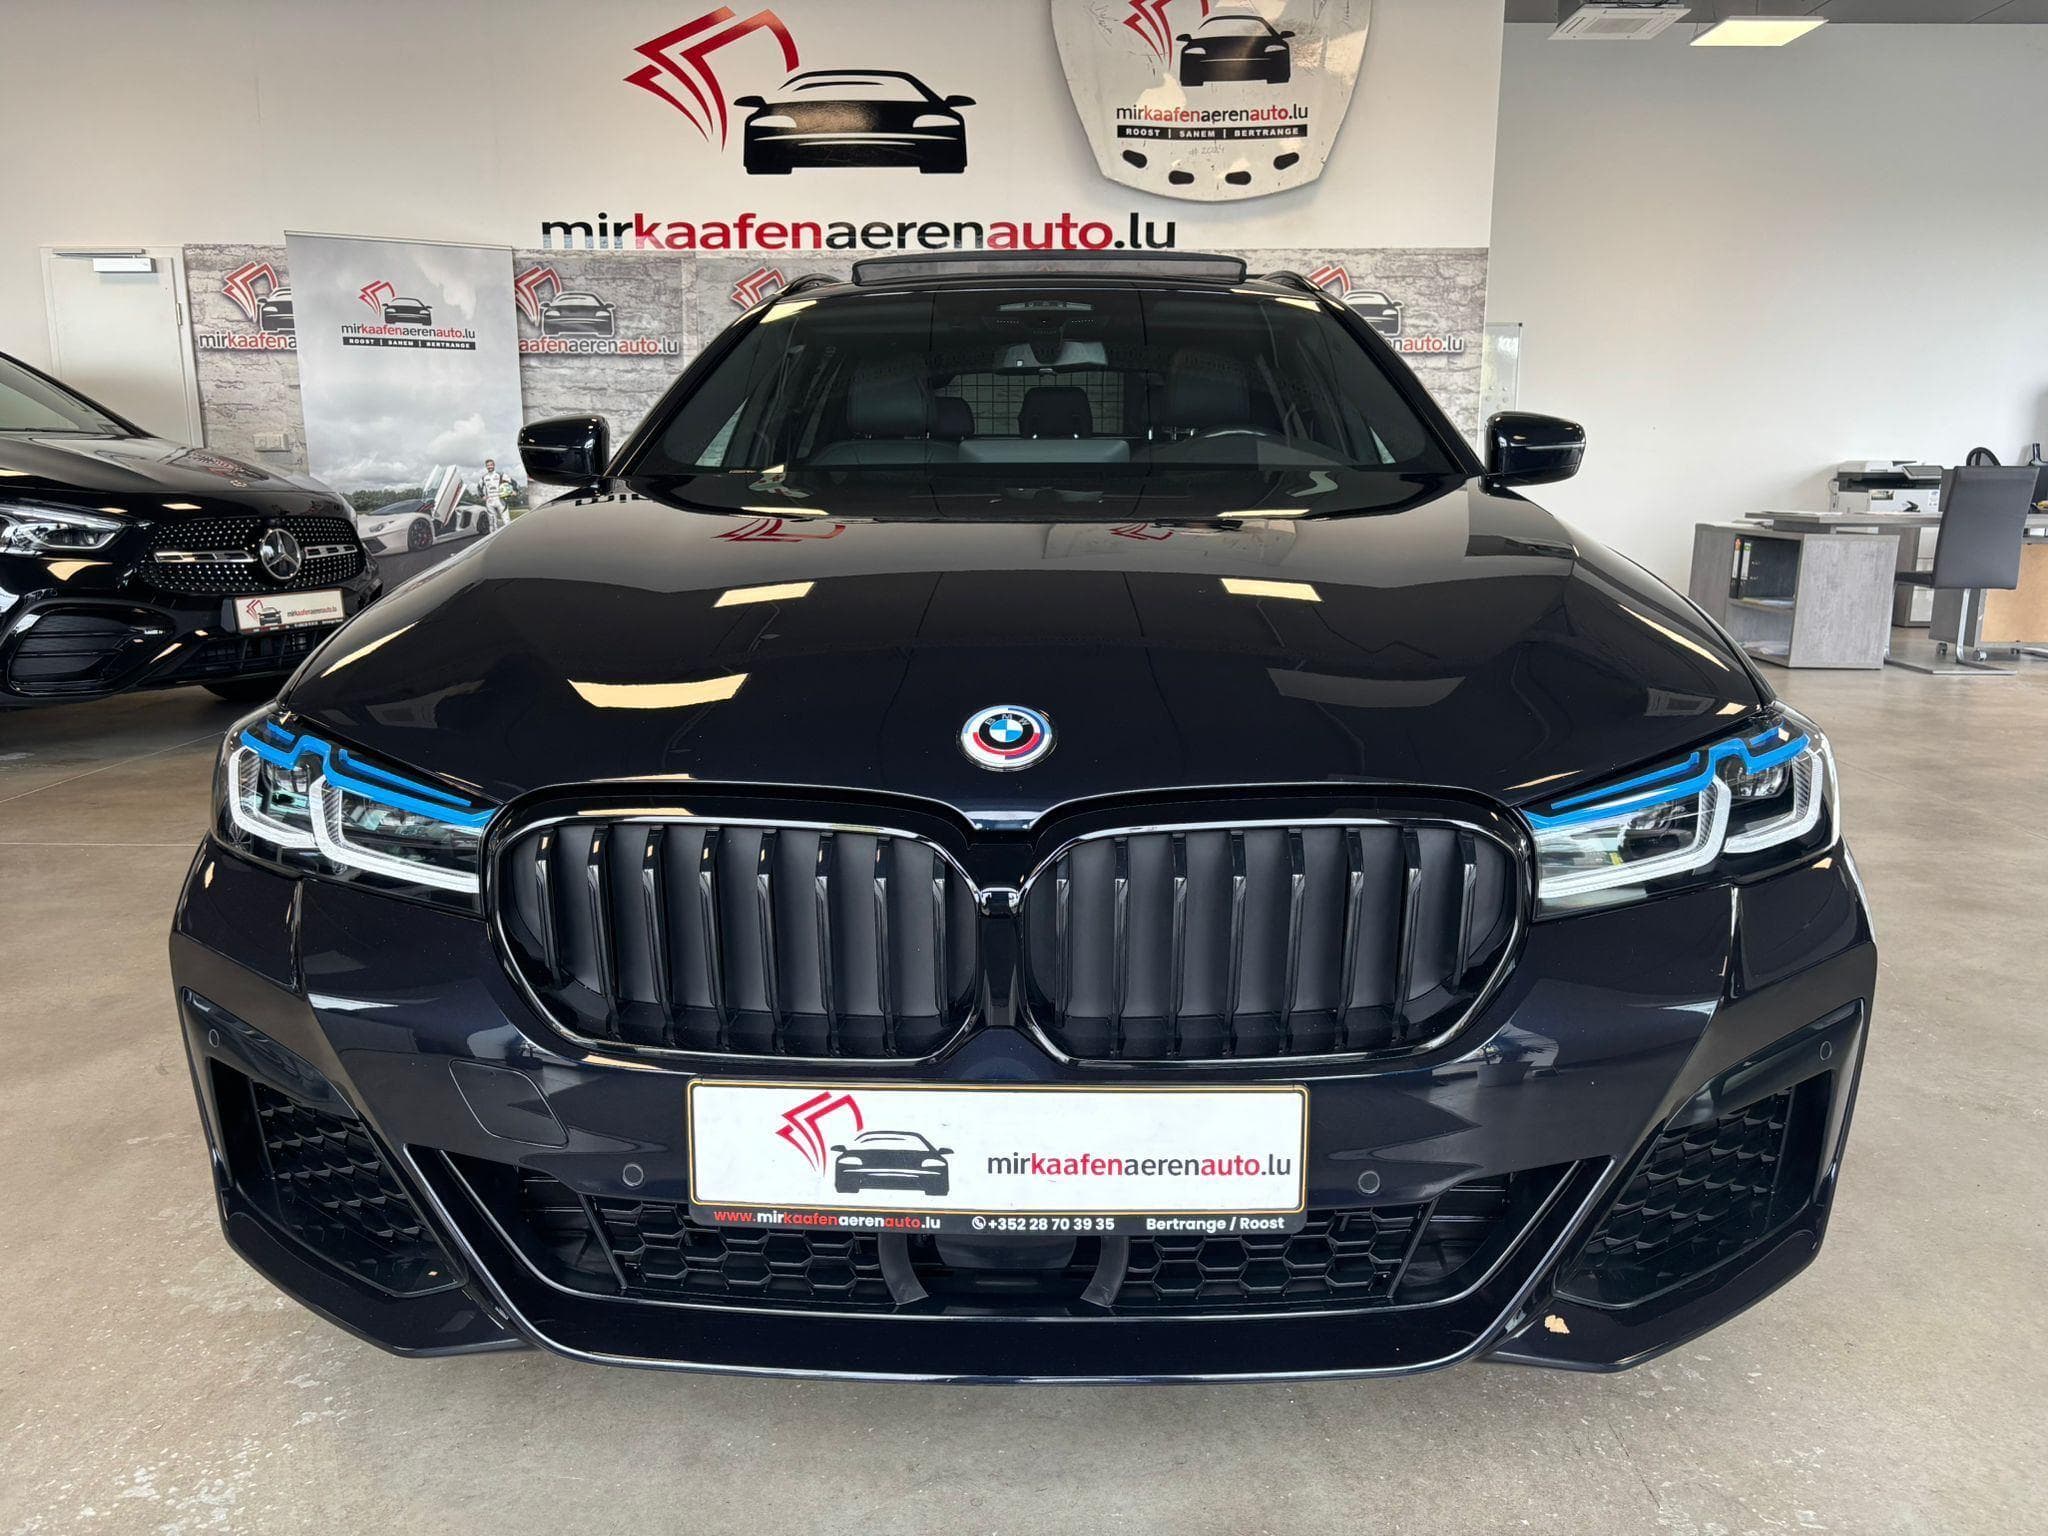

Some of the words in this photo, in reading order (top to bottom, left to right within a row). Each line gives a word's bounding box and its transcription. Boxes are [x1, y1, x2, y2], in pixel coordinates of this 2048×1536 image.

[1117, 104, 1308, 122] mirkaafenaerenauto.lu
[1126, 128, 1160, 137] ROOST
[1179, 130, 1216, 138] SANEM
[1234, 127, 1299, 137] BERTRANGE
[542, 212, 1175, 250] mirkaafenaerenauto.lu
[341, 324, 475, 339] mirkaafenaerenauto.lu
[987, 1152, 1291, 1176] mirkaafenaerenauto.lu
[713, 1210, 941, 1229] www.mirkaafenaerenauto.lu
[988, 1218, 1026, 1231] +352
[1029, 1218, 1048, 1231] 28
[1051, 1218, 1070, 1231] 70
[1073, 1218, 1092, 1231] 39
[1095, 1218, 1115, 1231] 35
[1146, 1217, 1227, 1234] Bertrange
[1240, 1217, 1285, 1230] Roost
